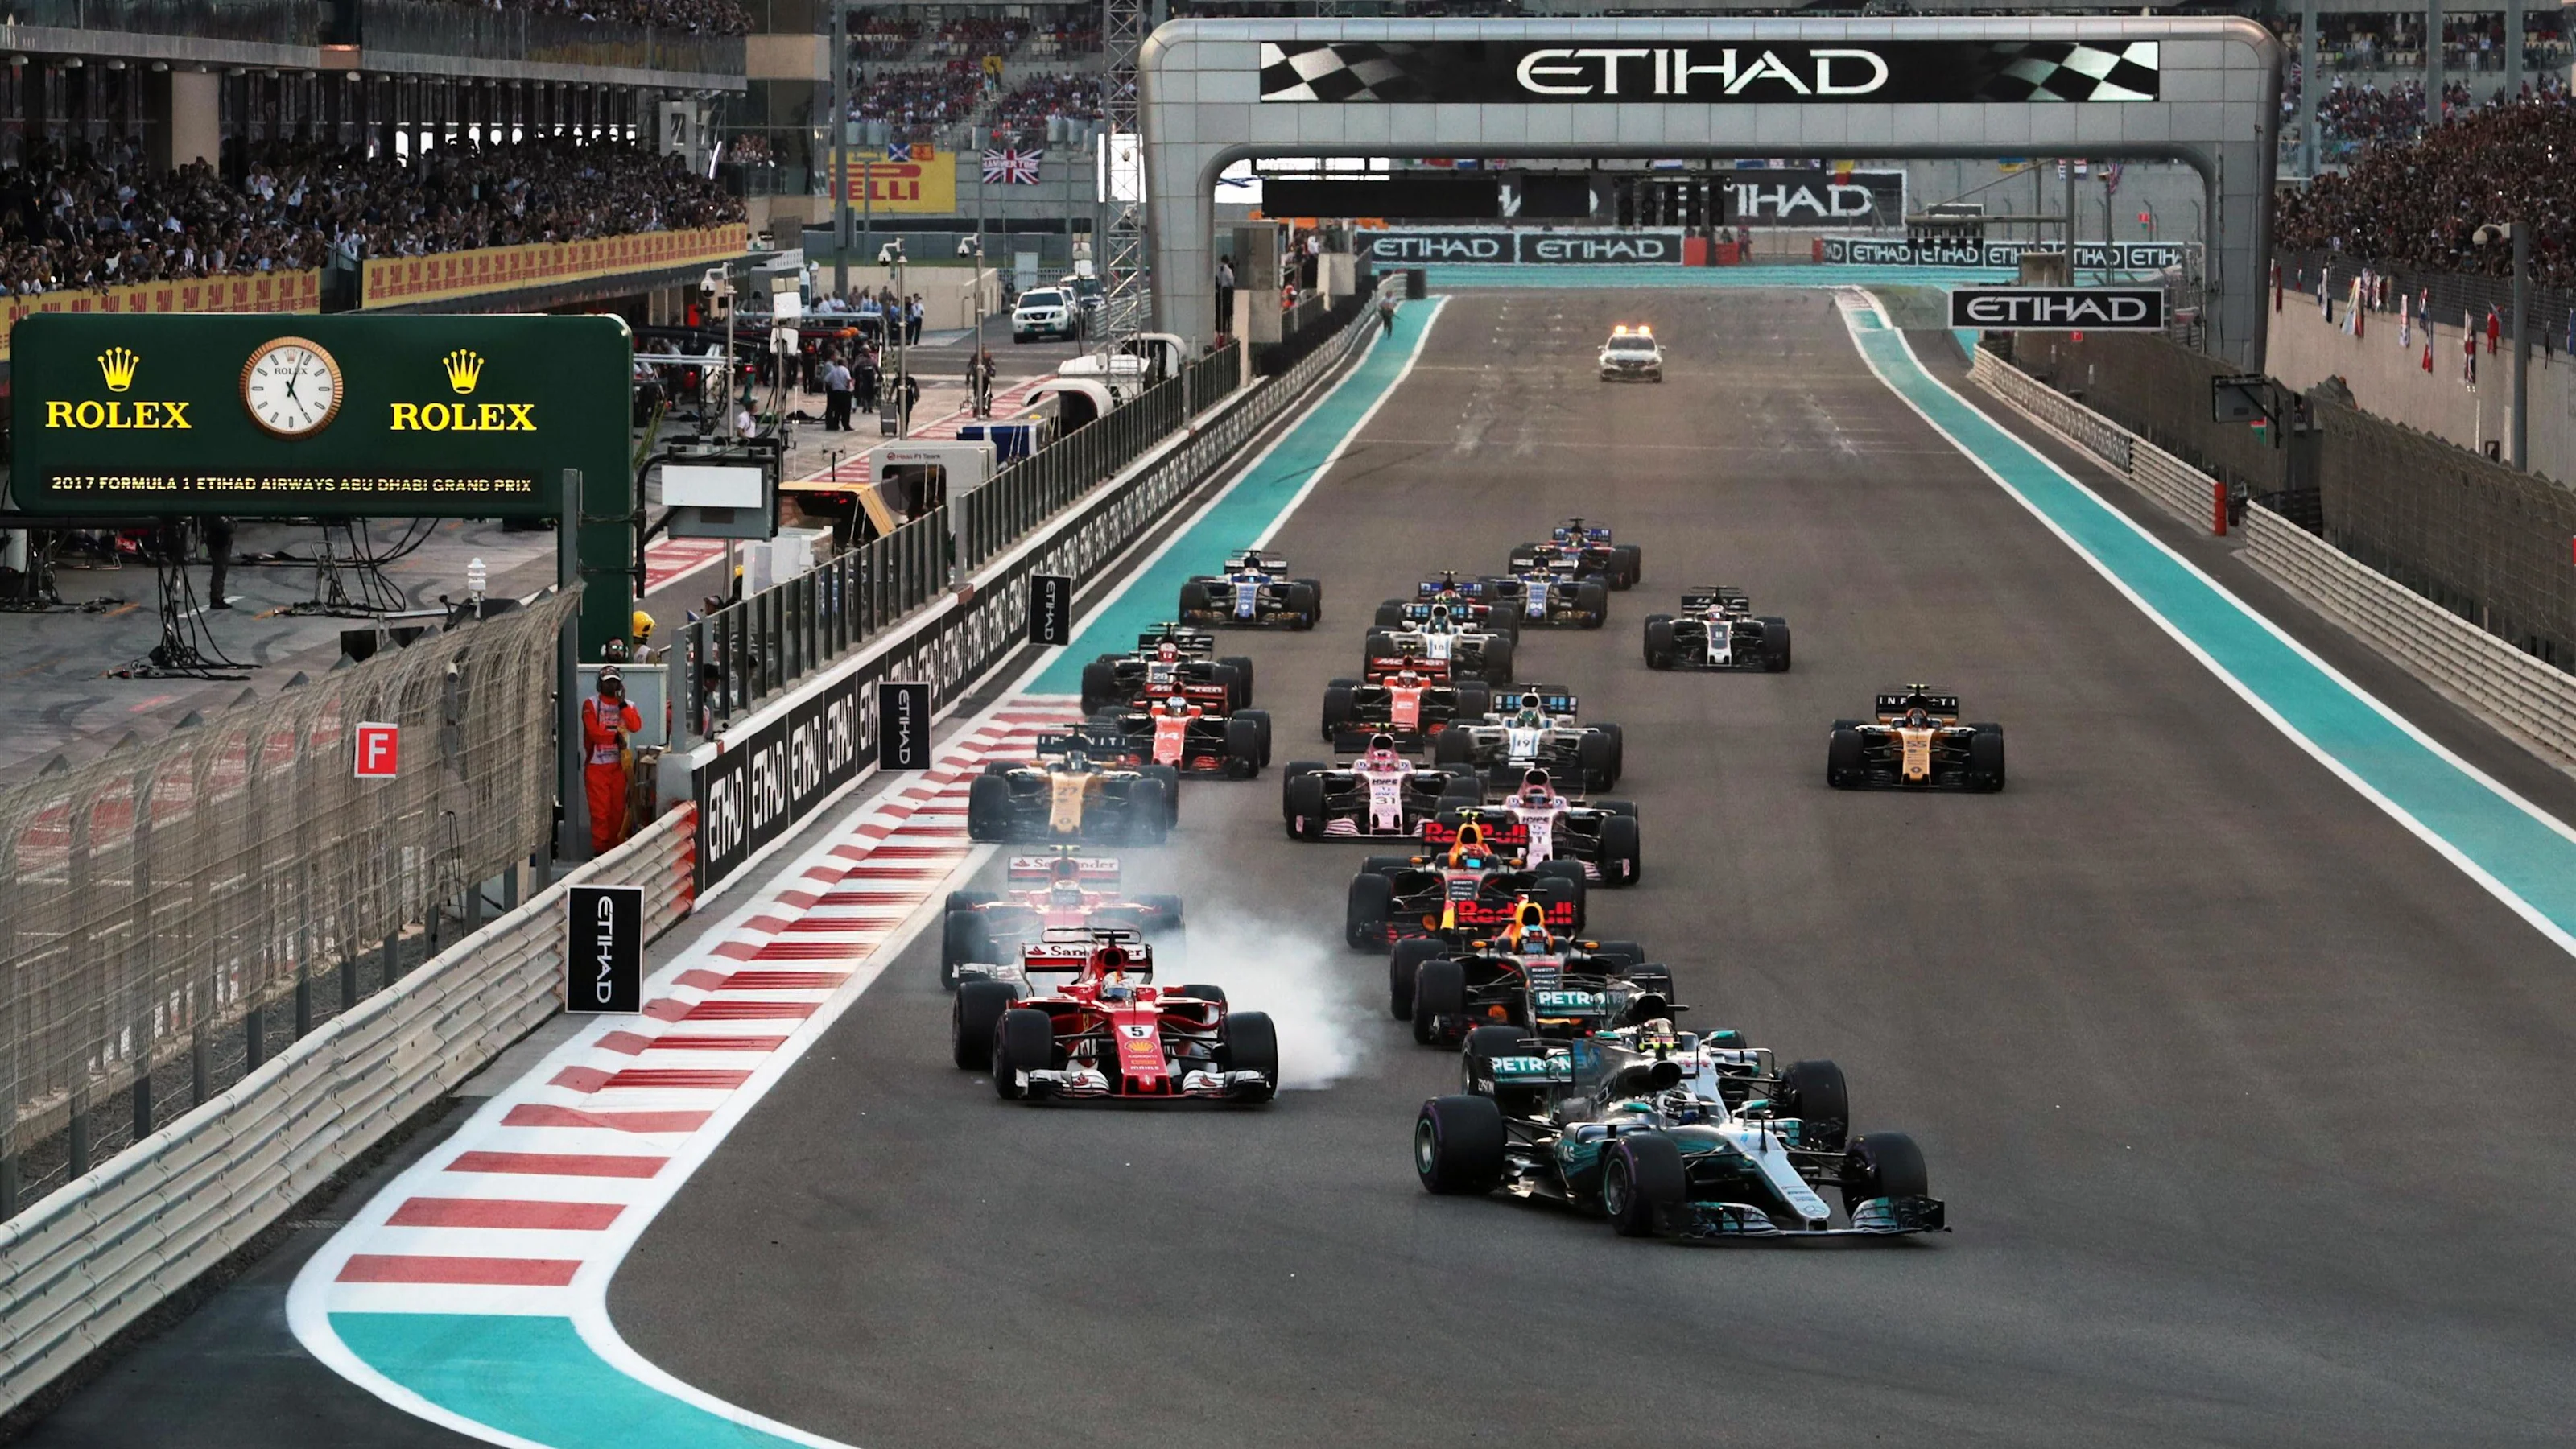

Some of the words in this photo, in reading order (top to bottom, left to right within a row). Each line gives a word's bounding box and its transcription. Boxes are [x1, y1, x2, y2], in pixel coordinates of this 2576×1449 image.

[1516, 48, 1889, 94] ETIHAD
[1373, 238, 1500, 258] ETIHAD
[1536, 239, 1665, 258] ETIHAD
[1853, 244, 1911, 262] ETIHAD
[2062, 248, 2120, 266] TIHAD
[1967, 296, 2148, 321] ETIHAD
[45, 400, 192, 429] ROLEX
[390, 402, 538, 431] ROLEX
[52, 477, 95, 489] 2017
[98, 477, 178, 490] FORMULA
[182, 477, 191, 490] 1
[196, 477, 256, 490] ETIHAD
[260, 477, 336, 491] AIRWAYS
[339, 478, 373, 491] ABU
[378, 478, 428, 492] DHABI
[432, 479, 490, 492] GRAND
[493, 479, 532, 492] PRIX
[1044, 580, 1056, 641] ETIHAD
[828, 693, 854, 774] ETIHAD
[898, 688, 910, 764] ETIHAD
[1158, 731, 1179, 740] 14
[368, 733, 389, 770] F
[1517, 740, 1530, 748] 19
[791, 715, 821, 802] ETIHAD
[752, 740, 786, 830] ETIHAD
[1056, 786, 1079, 795] 27
[1375, 796, 1396, 805] 31
[708, 766, 745, 863] ETIHAD
[1424, 823, 1458, 843] Re
[1457, 900, 1516, 923] Red
[597, 895, 614, 1004] ETIHAD
[1130, 1026, 1145, 1037] 5
